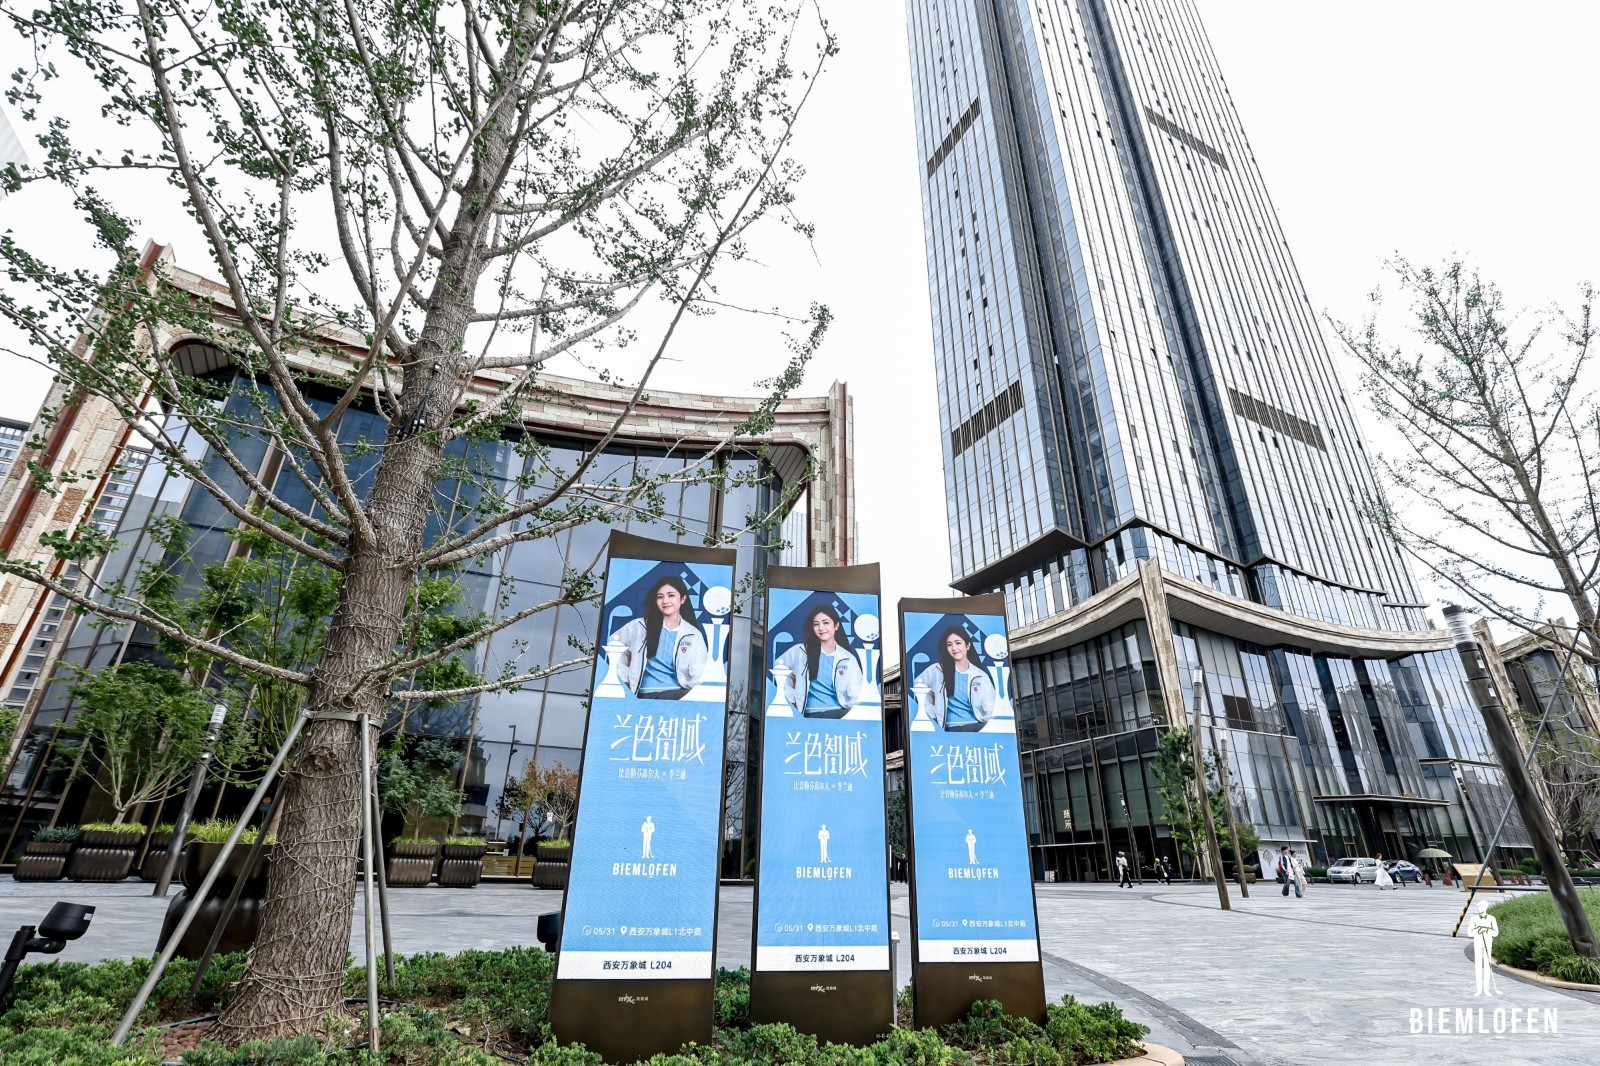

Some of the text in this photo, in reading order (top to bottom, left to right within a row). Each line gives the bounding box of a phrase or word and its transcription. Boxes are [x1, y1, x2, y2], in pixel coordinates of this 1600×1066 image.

[612, 863, 677, 879] BIEMLOFEN
[795, 866, 852, 881] BIEMLOFEN
[947, 867, 999, 881] BIEMLOFEN
[783, 924, 803, 933] 05/31
[941, 920, 959, 928] 05/31
[593, 927, 615, 936] 05/31
[952, 946, 1007, 956] 西安万象城 L204
[795, 954, 855, 963] 西安万象城 L204
[602, 960, 672, 970] 西安万象城 L204
